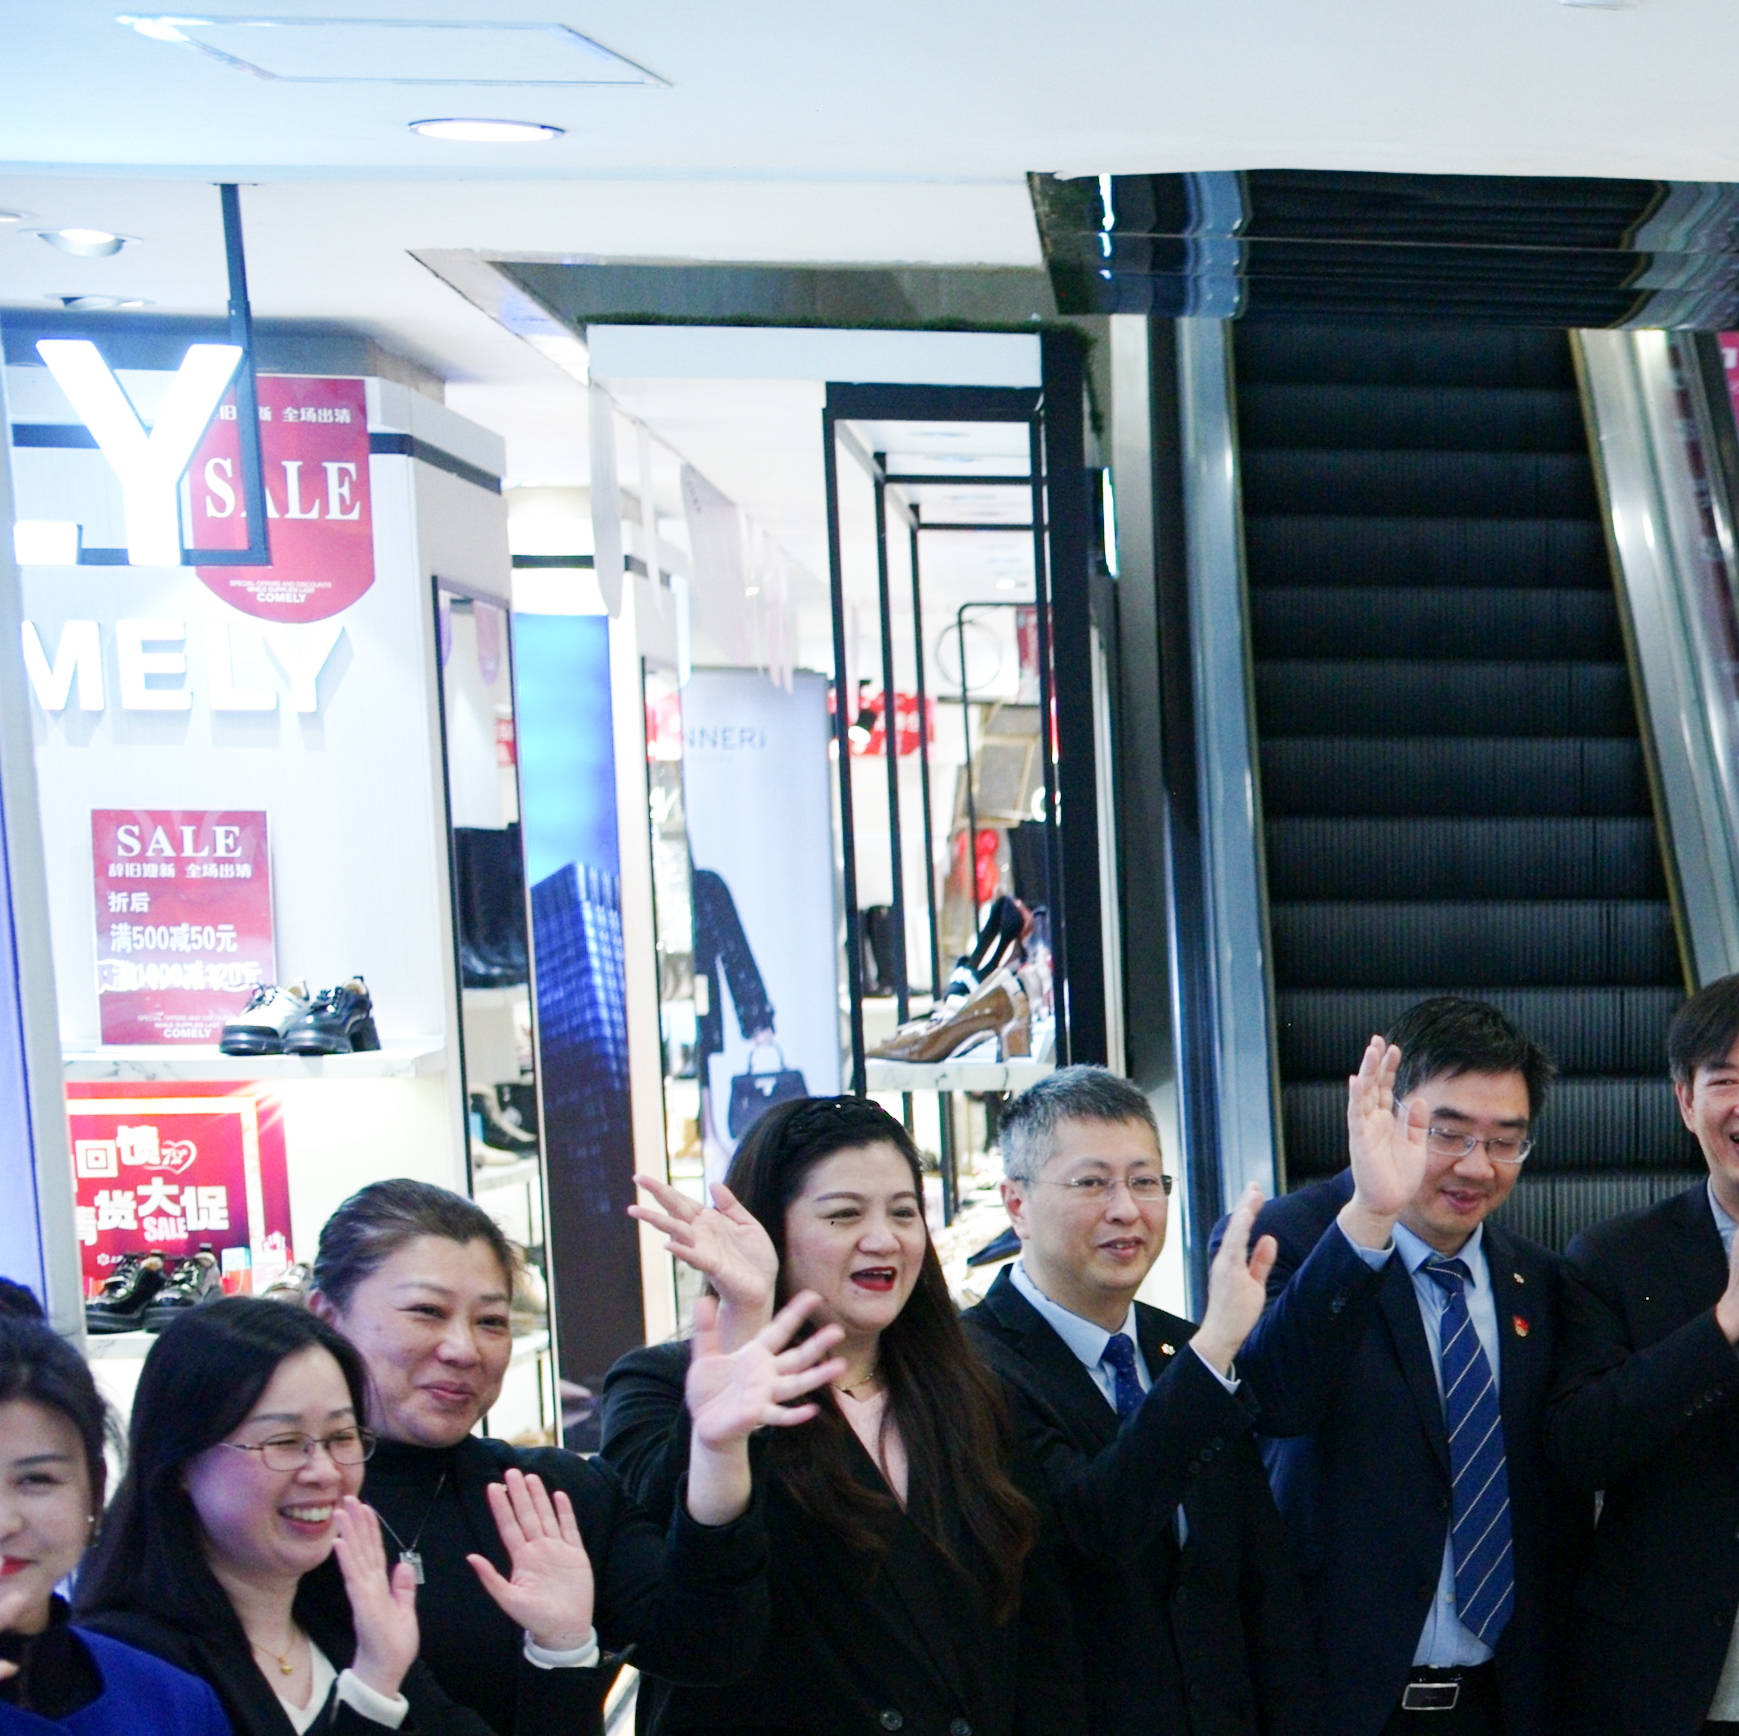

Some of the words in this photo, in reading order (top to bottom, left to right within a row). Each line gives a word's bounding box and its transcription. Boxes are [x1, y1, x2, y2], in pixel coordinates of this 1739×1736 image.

[283, 407, 351, 424] 全场出清
[256, 592, 307, 603] COMELY
[116, 824, 242, 858] SALE
[108, 891, 151, 913] 折后
[110, 922, 239, 953] 满500减50元
[163, 1028, 211, 1039] COMELY
[142, 1217, 189, 1242] SALE
